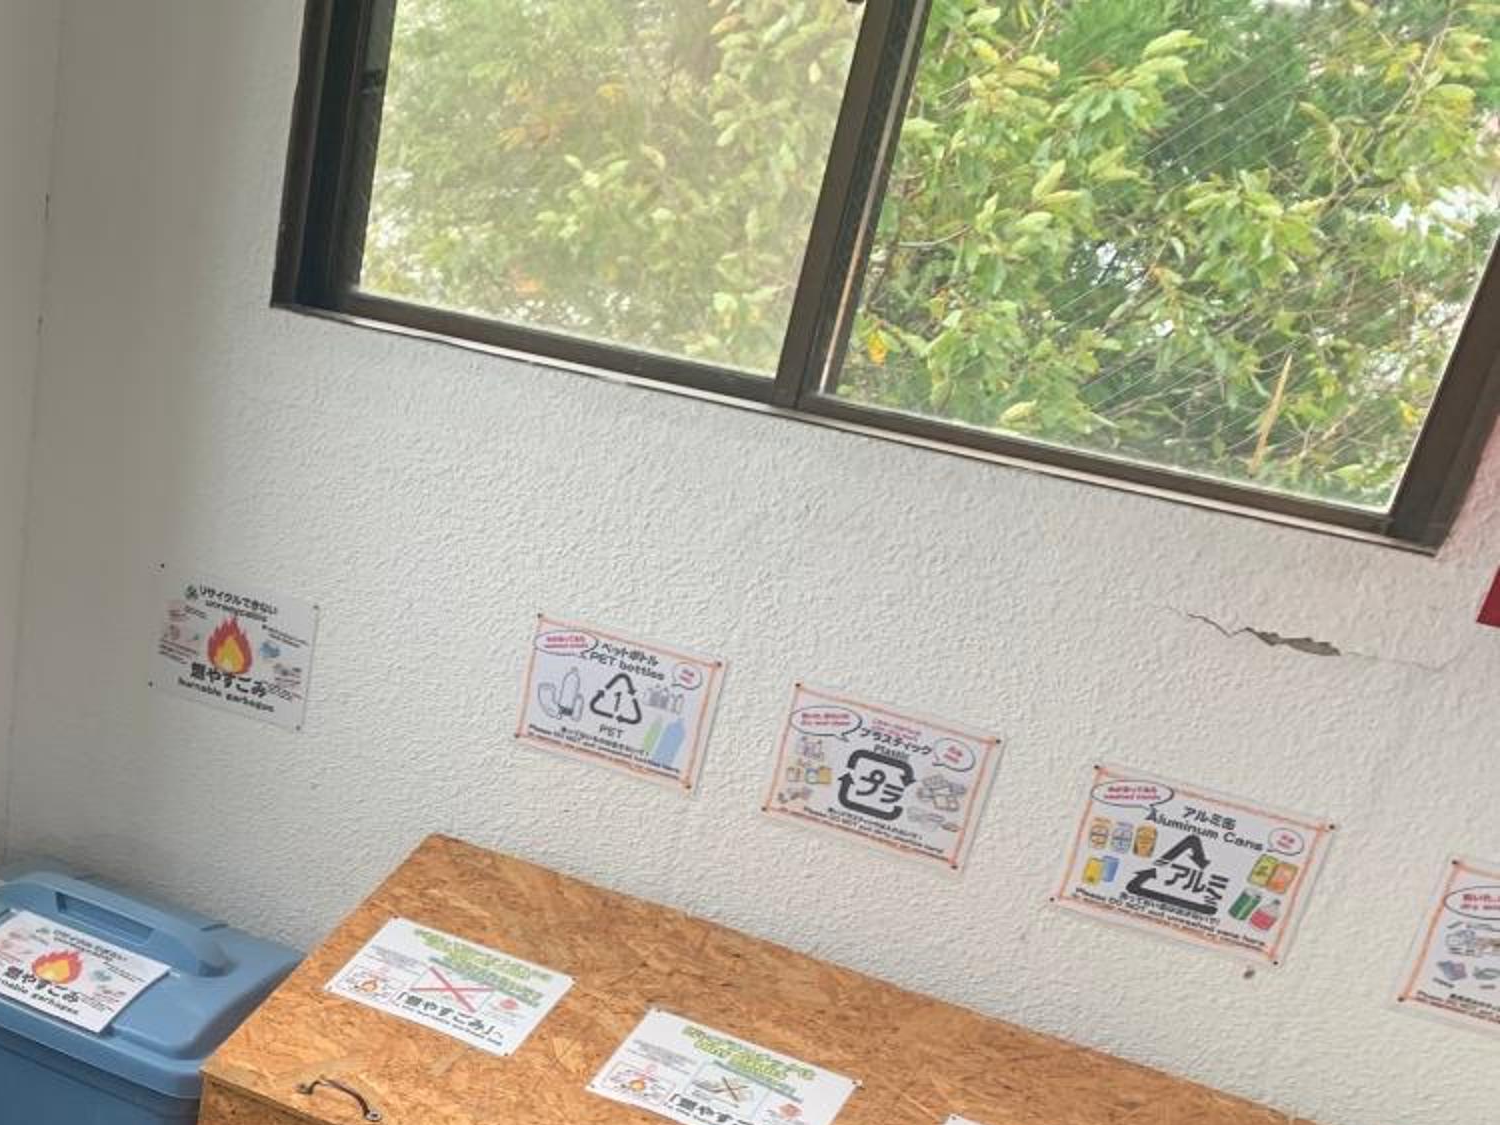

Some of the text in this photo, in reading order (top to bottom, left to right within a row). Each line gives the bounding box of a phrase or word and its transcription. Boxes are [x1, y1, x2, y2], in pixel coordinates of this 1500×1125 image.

[589, 651, 615, 668] PET
[599, 723, 625, 739] PET
[856, 769, 904, 803] プラ
[1145, 809, 1219, 840] Aluminum
[1223, 832, 1264, 851] Cans
[1182, 805, 1237, 831] アルミ缶
[1164, 863, 1229, 903] アルミ
